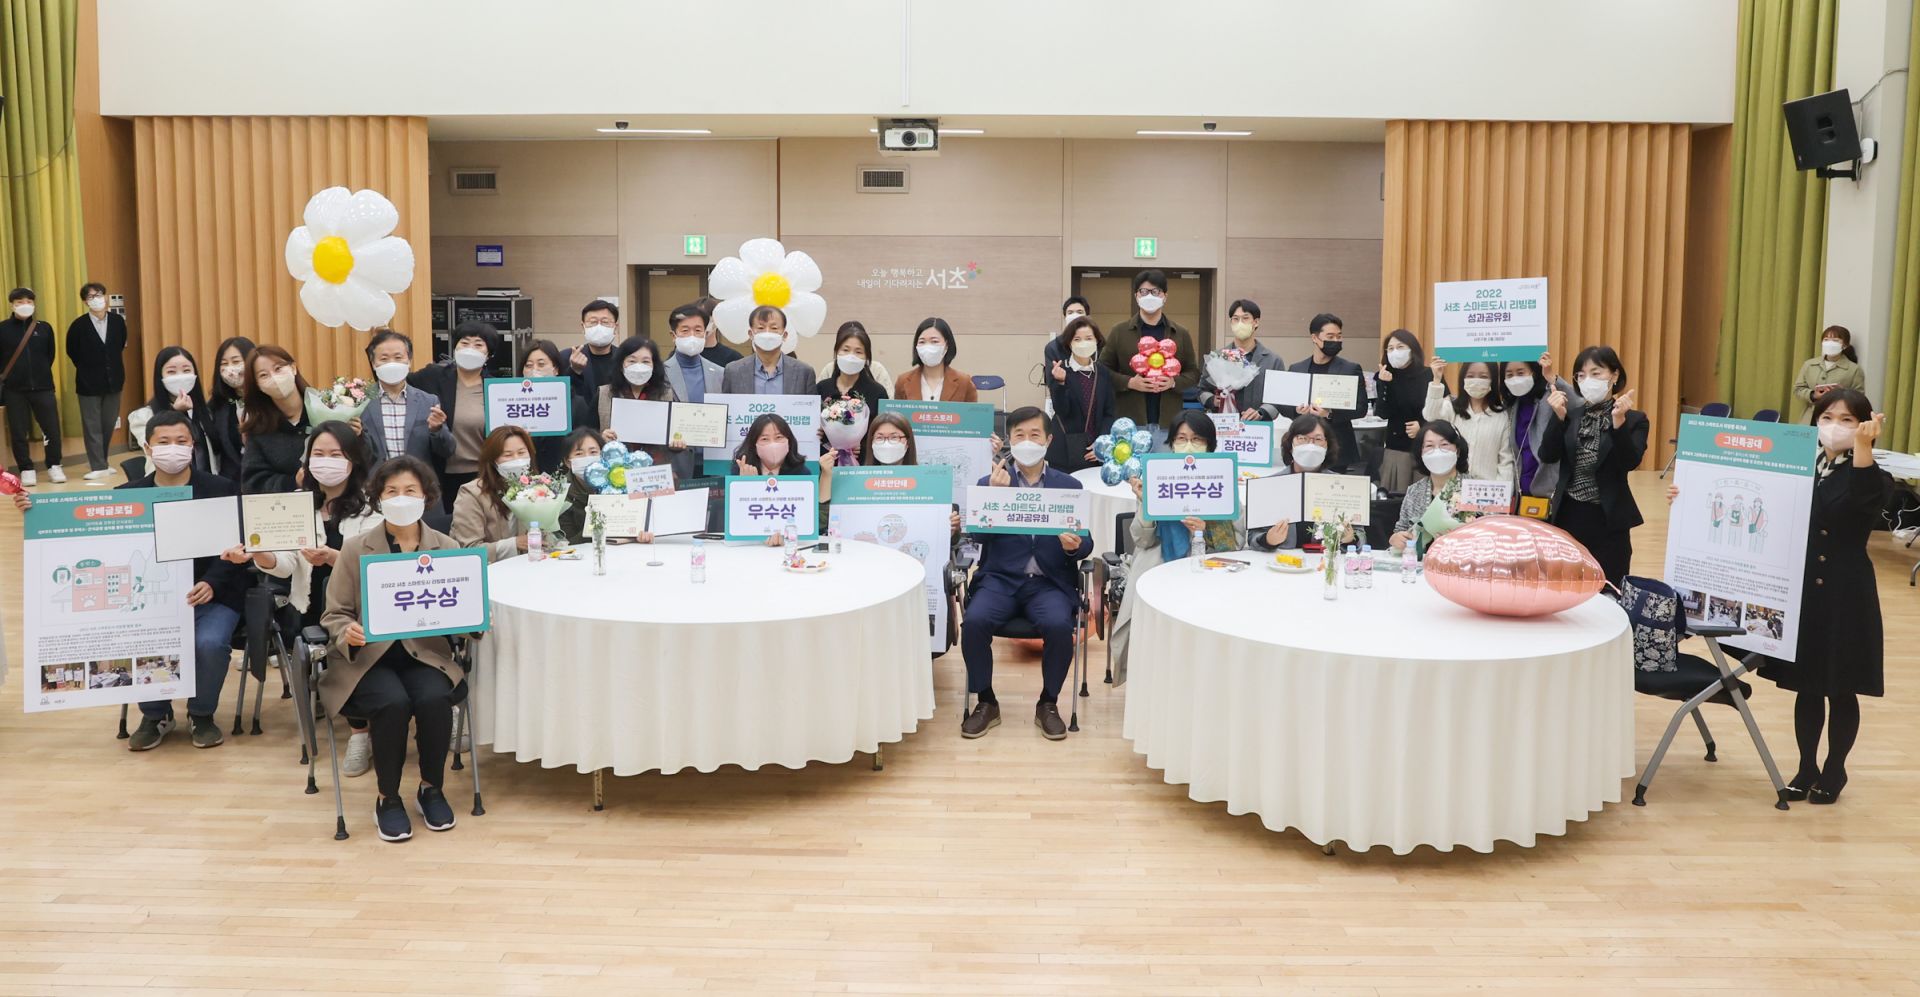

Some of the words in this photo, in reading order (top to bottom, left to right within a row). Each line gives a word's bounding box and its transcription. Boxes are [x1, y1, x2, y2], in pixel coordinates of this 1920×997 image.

[872, 268, 887, 277] 오늘
[890, 268, 924, 278] 행복하고
[926, 267, 968, 290] 서초
[856, 280, 881, 288] 내일이
[884, 280, 923, 288] 기다려지는
[1476, 289, 1502, 299] 2022
[1443, 302, 1460, 312] 서초
[1463, 300, 1507, 311] 스마트도시
[1510, 299, 1537, 310] 리빙랩
[1468, 312, 1511, 323] 성과공유회
[506, 403, 550, 418] 장려상
[749, 403, 776, 413] 2022
[784, 415, 811, 425] 리빙랩
[933, 414, 953, 422] 스토리
[1224, 440, 1258, 452] 장려상
[1723, 435, 1763, 448] 그린특공대
[1158, 482, 1224, 499] 최우수상
[1016, 493, 1042, 502] 2022
[85, 504, 133, 517] 방배글로컬
[748, 504, 796, 520] 우수상
[982, 502, 999, 511] 서초
[1003, 503, 1045, 513] 스마트도시
[1048, 504, 1074, 513] 리빙랩
[1007, 513, 1049, 523] 성과공유회
[394, 586, 459, 611] 우수상
